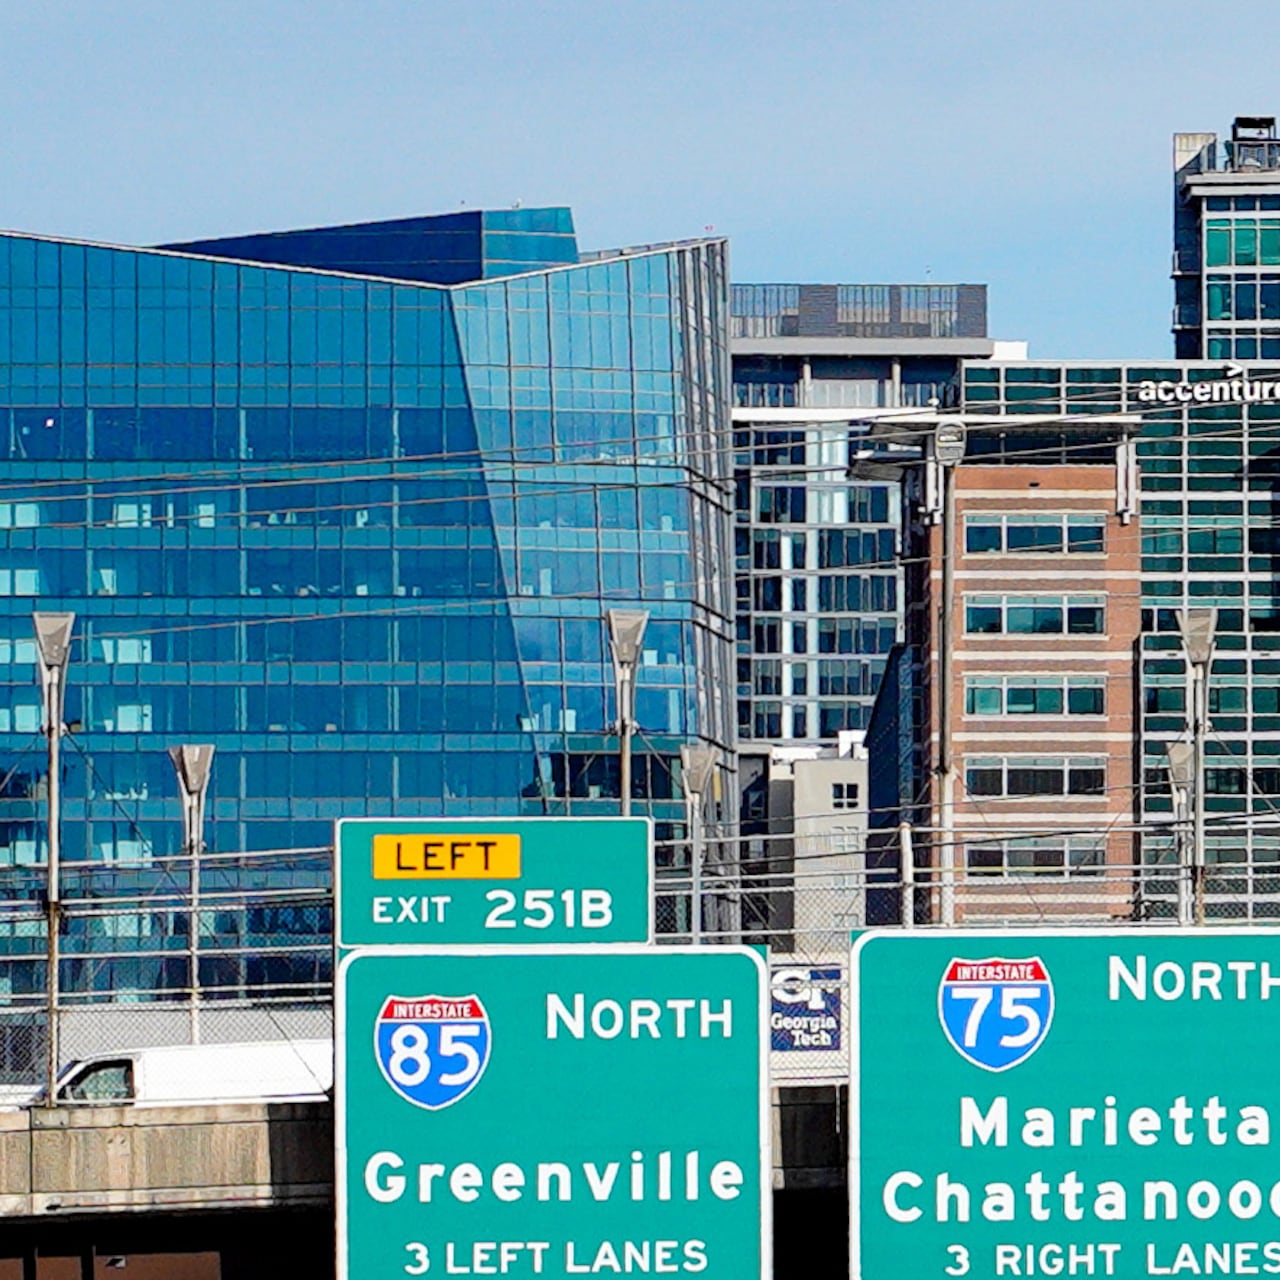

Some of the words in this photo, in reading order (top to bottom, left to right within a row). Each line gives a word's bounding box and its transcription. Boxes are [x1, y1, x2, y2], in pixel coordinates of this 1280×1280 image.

[396, 841, 497, 871] LEFT
[372, 896, 451, 924] EXIT
[484, 889, 613, 929] 251B
[956, 965, 1035, 981] INTERSTATE
[393, 1002, 472, 1020] INTERSTATE
[546, 993, 733, 1039] NORTH
[771, 1012, 838, 1033] Georgia
[950, 987, 1042, 1048] 75
[388, 1024, 480, 1087] 85
[791, 1030, 832, 1046] Tech
[959, 1096, 1272, 1148] Marietta
[364, 1151, 744, 1203] Greenville
[404, 1242, 430, 1275] 3
[446, 1242, 551, 1274] LEFT
[565, 1240, 709, 1272] LANES
[945, 1245, 970, 1276] 3
[996, 1243, 1121, 1276] RIGHT
